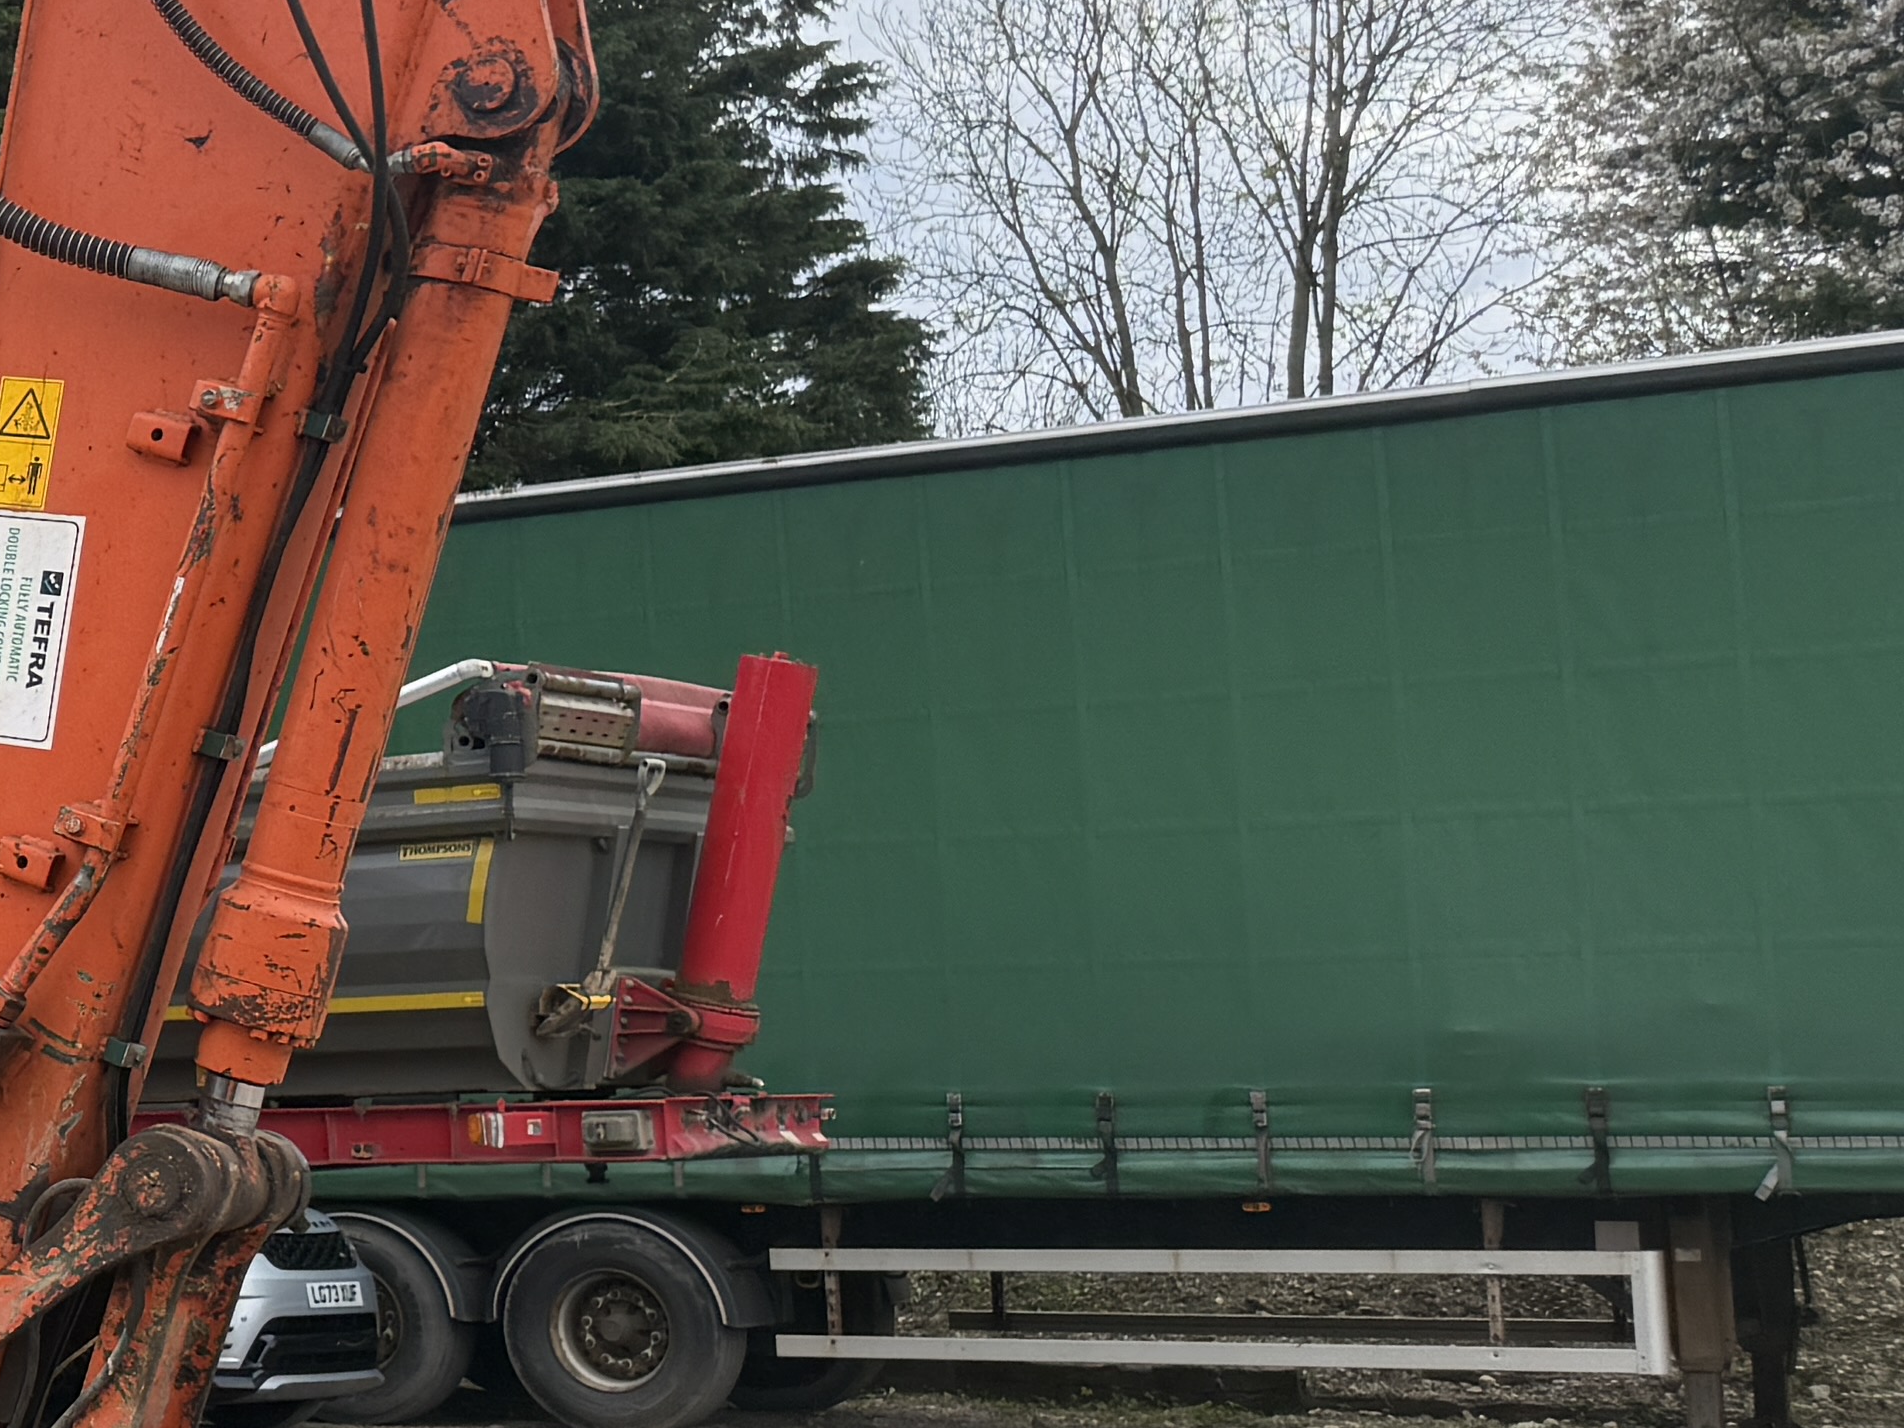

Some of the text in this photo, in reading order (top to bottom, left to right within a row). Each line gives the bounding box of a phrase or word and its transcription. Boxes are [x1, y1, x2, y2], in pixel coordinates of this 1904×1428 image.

[2, 526, 21, 575] DOUBLE
[5, 576, 34, 683] FULLY AUTOMATIC
[25, 600, 55, 689] TEFRA
[402, 842, 472, 858] THOMPSONS
